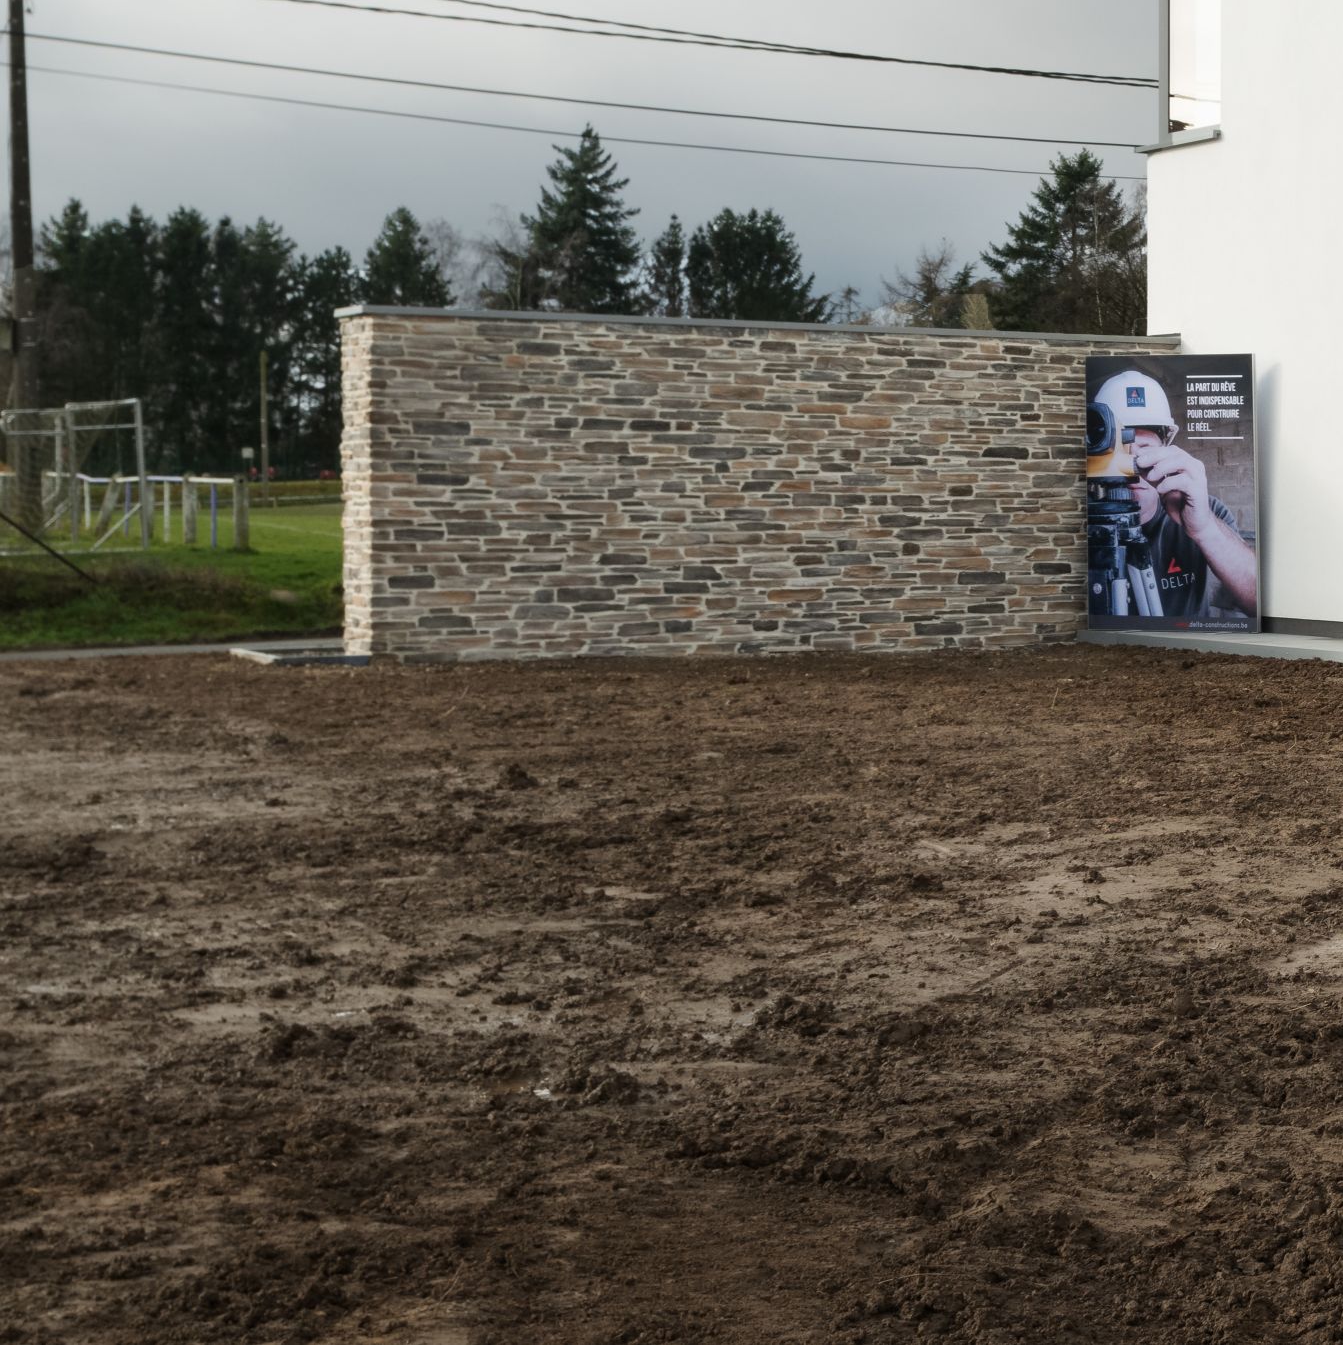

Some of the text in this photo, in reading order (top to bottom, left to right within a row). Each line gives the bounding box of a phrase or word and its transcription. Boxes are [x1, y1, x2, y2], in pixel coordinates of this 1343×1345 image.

[1187, 381, 1236, 392] LA PART DU RÊVE
[1187, 396, 1244, 405] EST INDISPENSABLE
[1187, 409, 1240, 418] POUR CONSTRUIRE
[1188, 421, 1212, 431] LE RÉEL.
[1161, 572, 1196, 589] DELTA
[1175, 621, 1248, 629] delta-constructions.be
